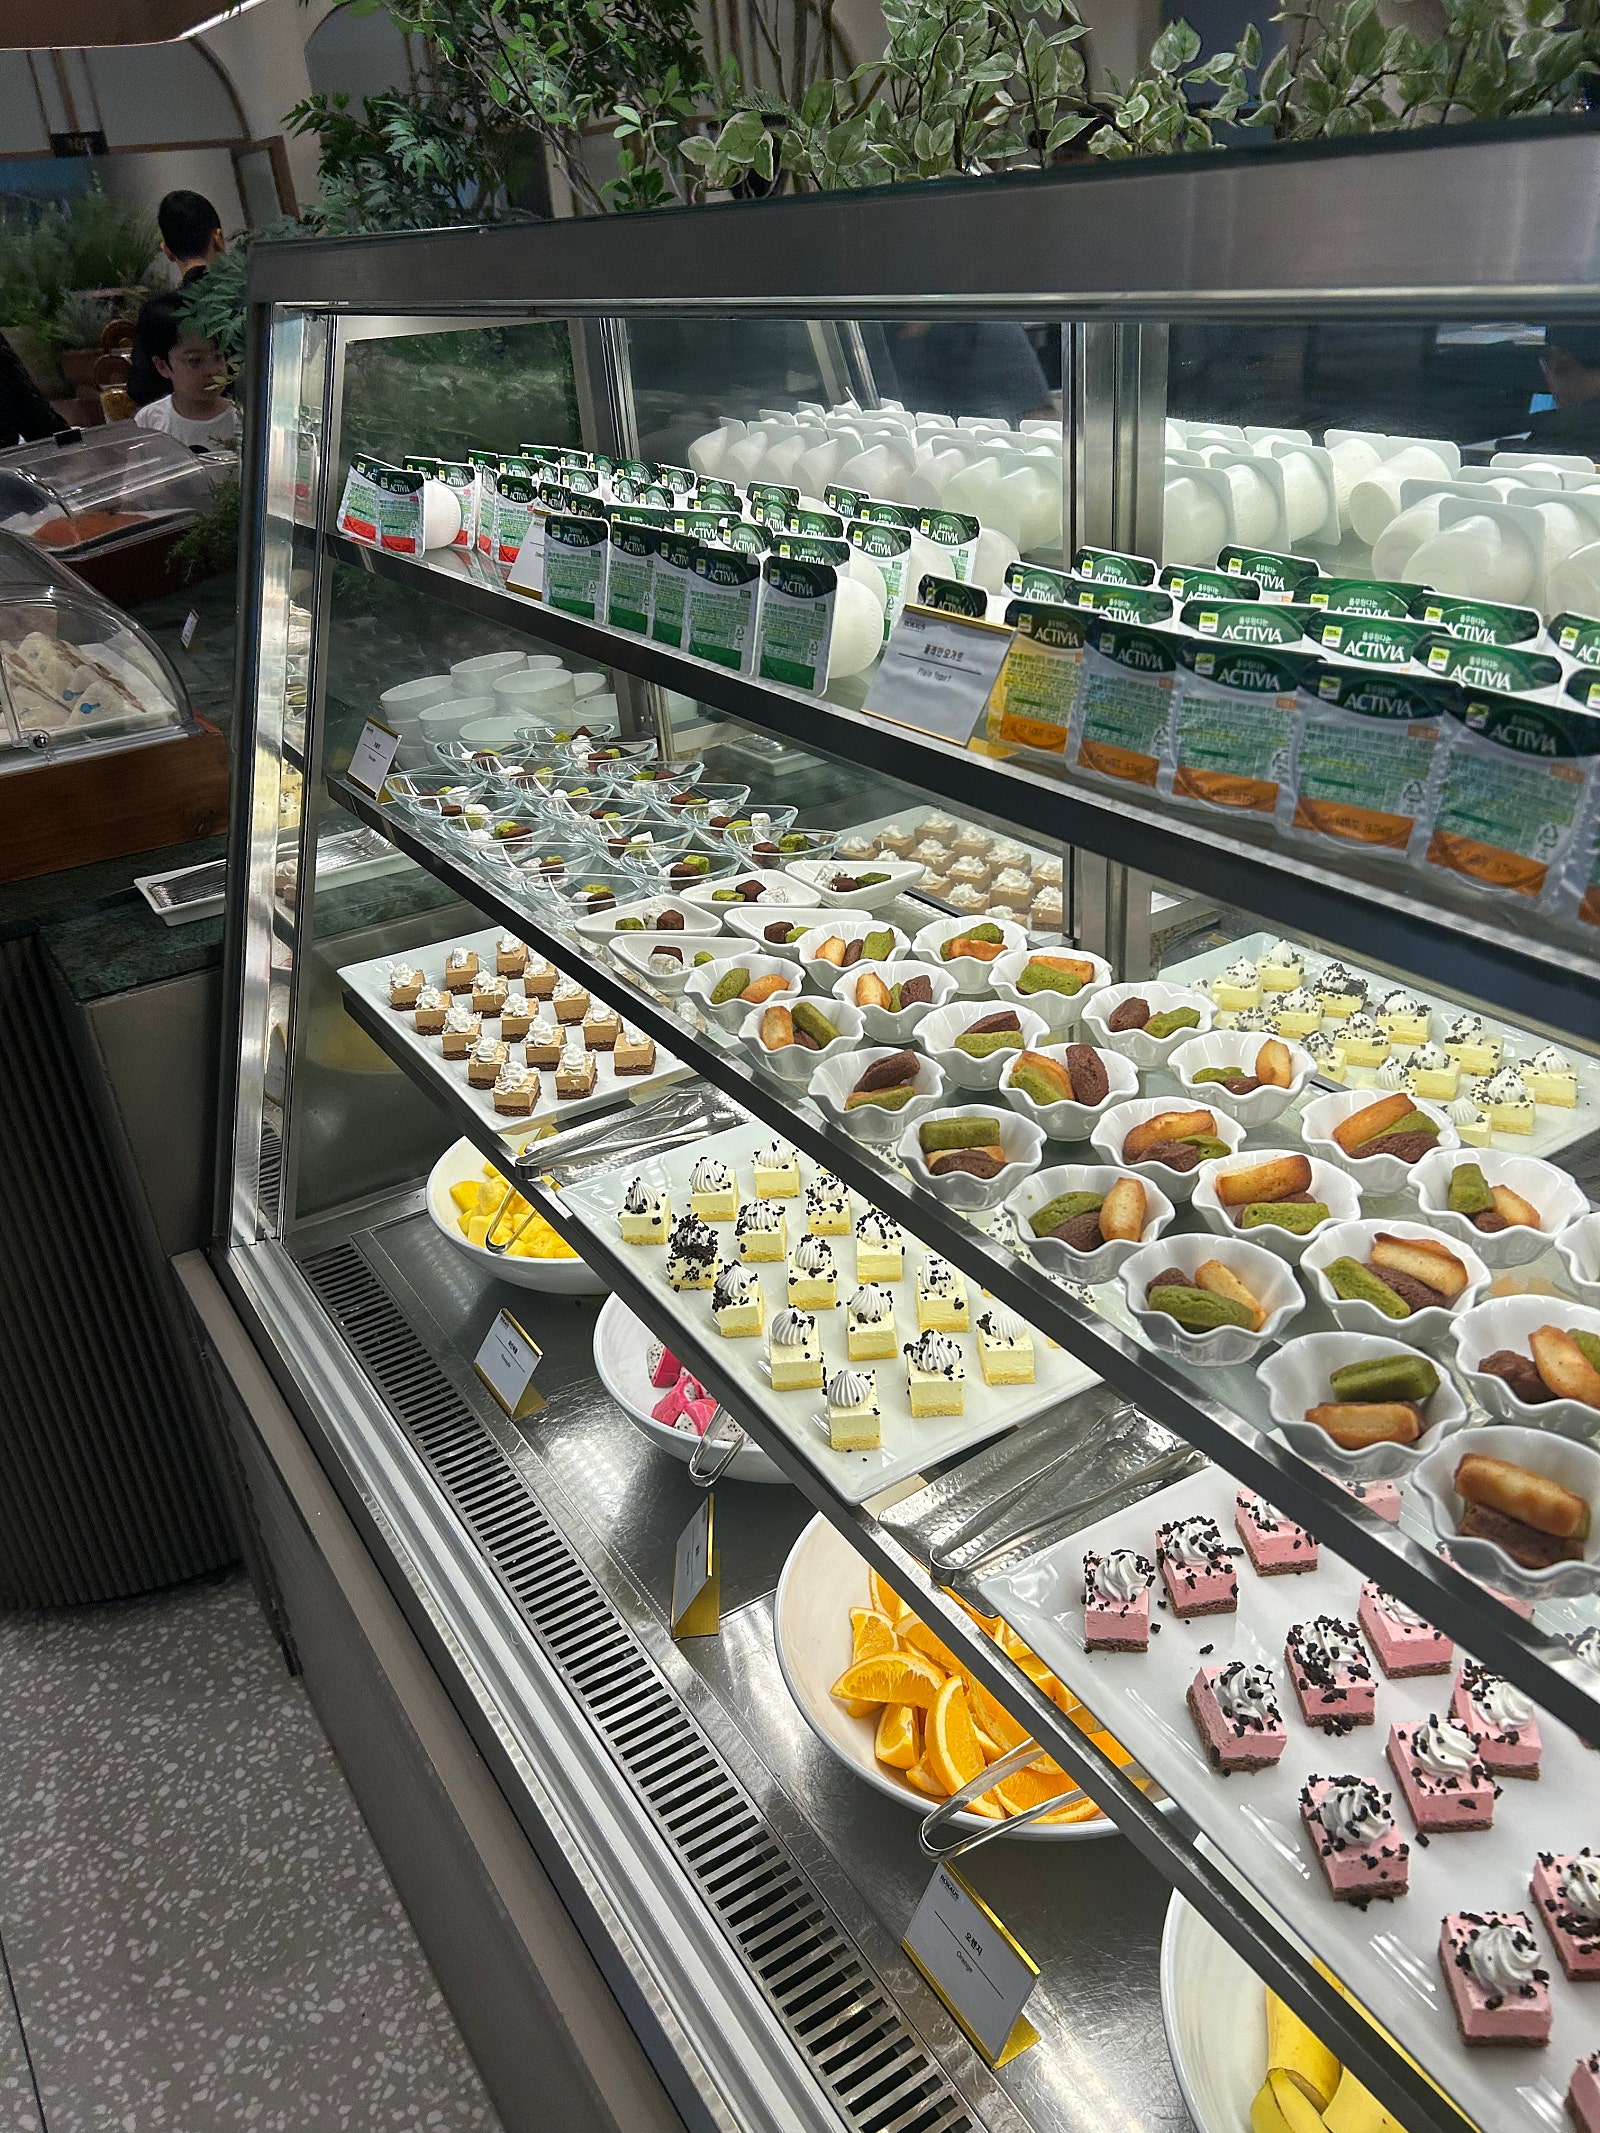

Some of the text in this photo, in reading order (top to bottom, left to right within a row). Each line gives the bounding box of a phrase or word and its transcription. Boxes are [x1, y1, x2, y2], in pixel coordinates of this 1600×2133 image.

[563, 533, 590, 546] ACTIVIA
[687, 527, 718, 539] ACTIVIA
[931, 529, 959, 544] ACTIVIA
[622, 540, 646, 554] ACTIVIA
[733, 540, 756, 554] ACTIVIA
[864, 540, 892, 556] ACTIVIA
[708, 571, 738, 584] ACTIVIA
[782, 582, 813, 597] ACTIVIA
[1023, 587, 1055, 603] ACTIVIA
[1034, 627, 1079, 648] ACTIVIA
[1222, 625, 1283, 644] ACTIVIA
[1117, 650, 1163, 671] ACTIVIA
[1343, 640, 1405, 662] ACTIVIA
[1217, 668, 1280, 692] ACTIVIA
[1450, 664, 1512, 691] ACTIVIA
[1344, 693, 1413, 718] ACTIVIA
[1489, 723, 1557, 755] ACTIVIA
[965, 1932, 983, 1956] 오렌지
[956, 1951, 973, 1974] Orange
